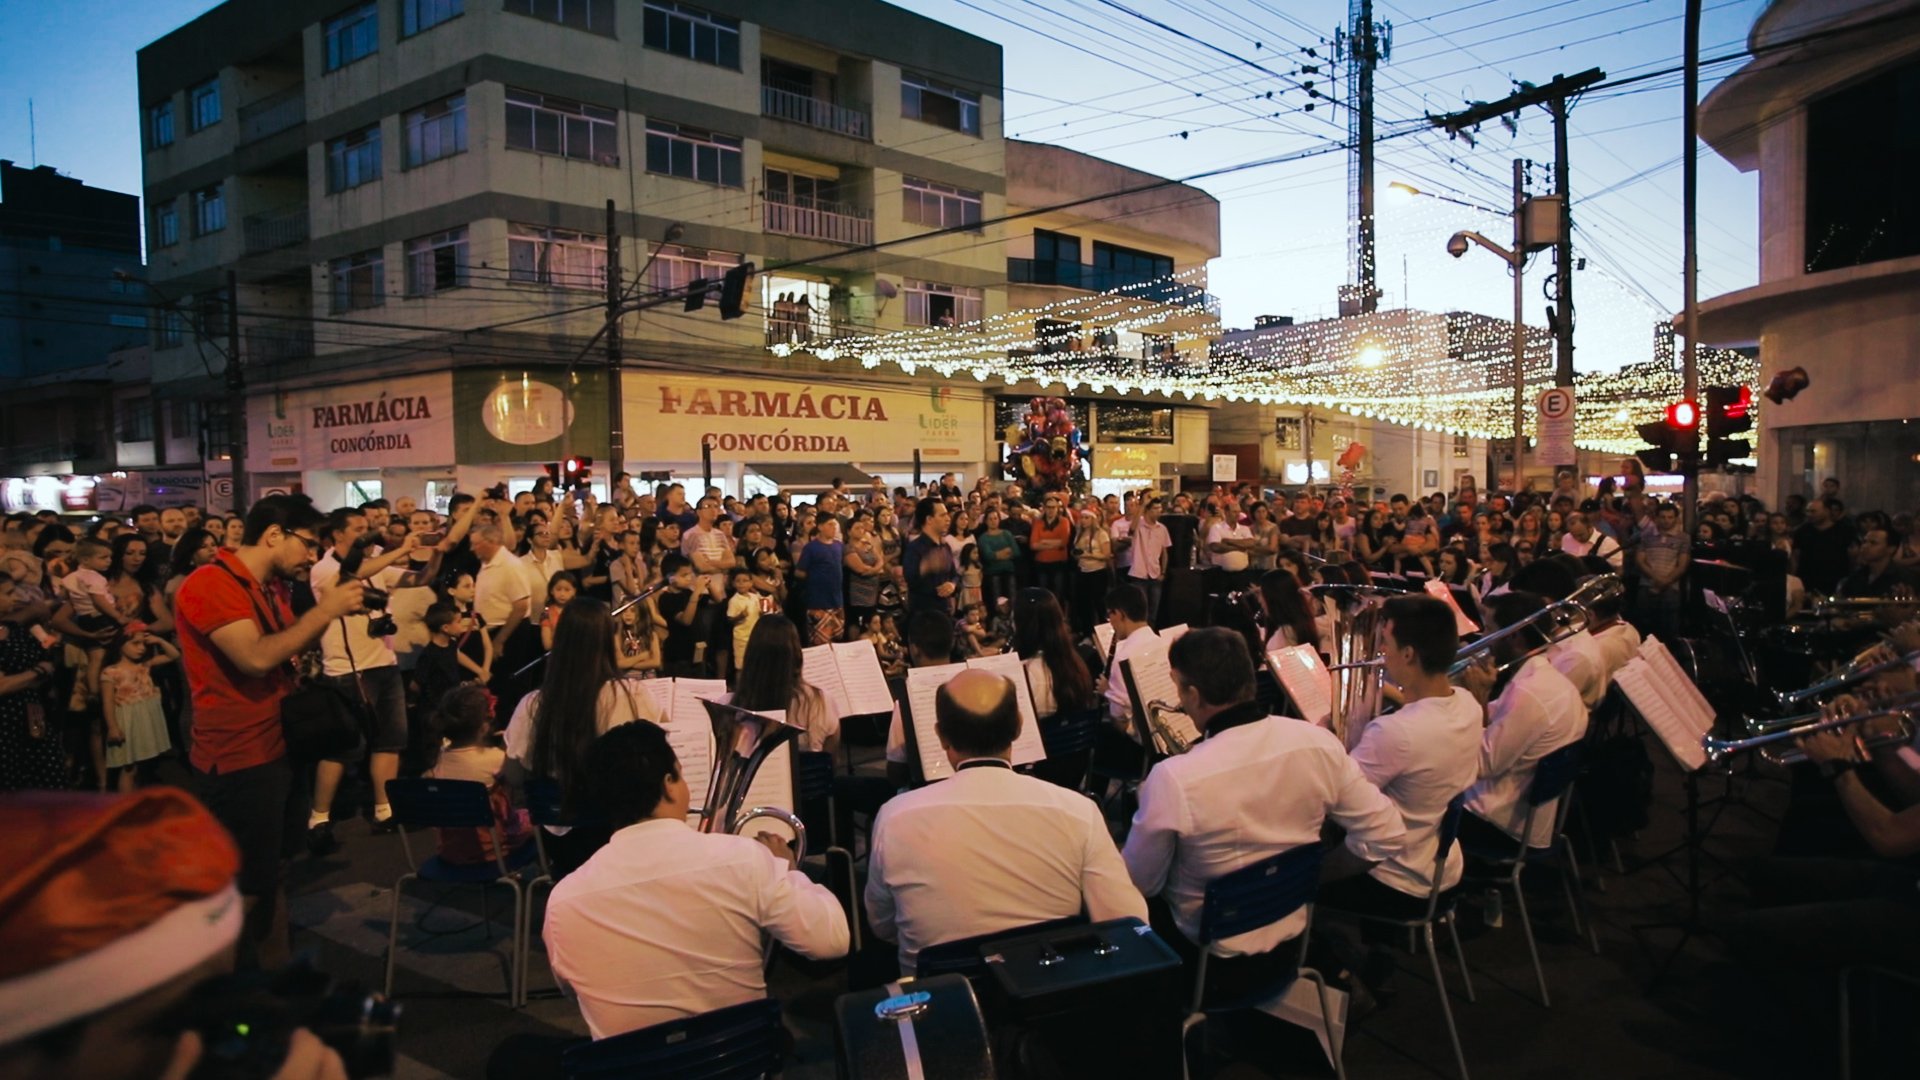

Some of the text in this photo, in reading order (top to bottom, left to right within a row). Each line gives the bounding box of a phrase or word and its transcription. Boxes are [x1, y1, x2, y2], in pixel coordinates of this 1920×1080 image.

[312, 391, 431, 428] FARMÁCIA
[658, 385, 888, 421] FARMÁCIA
[1548, 395, 1561, 412] E
[330, 430, 411, 453] CONCÓRDIA
[701, 427, 850, 452] CONCÓRDIA
[221, 482, 230, 494] E
